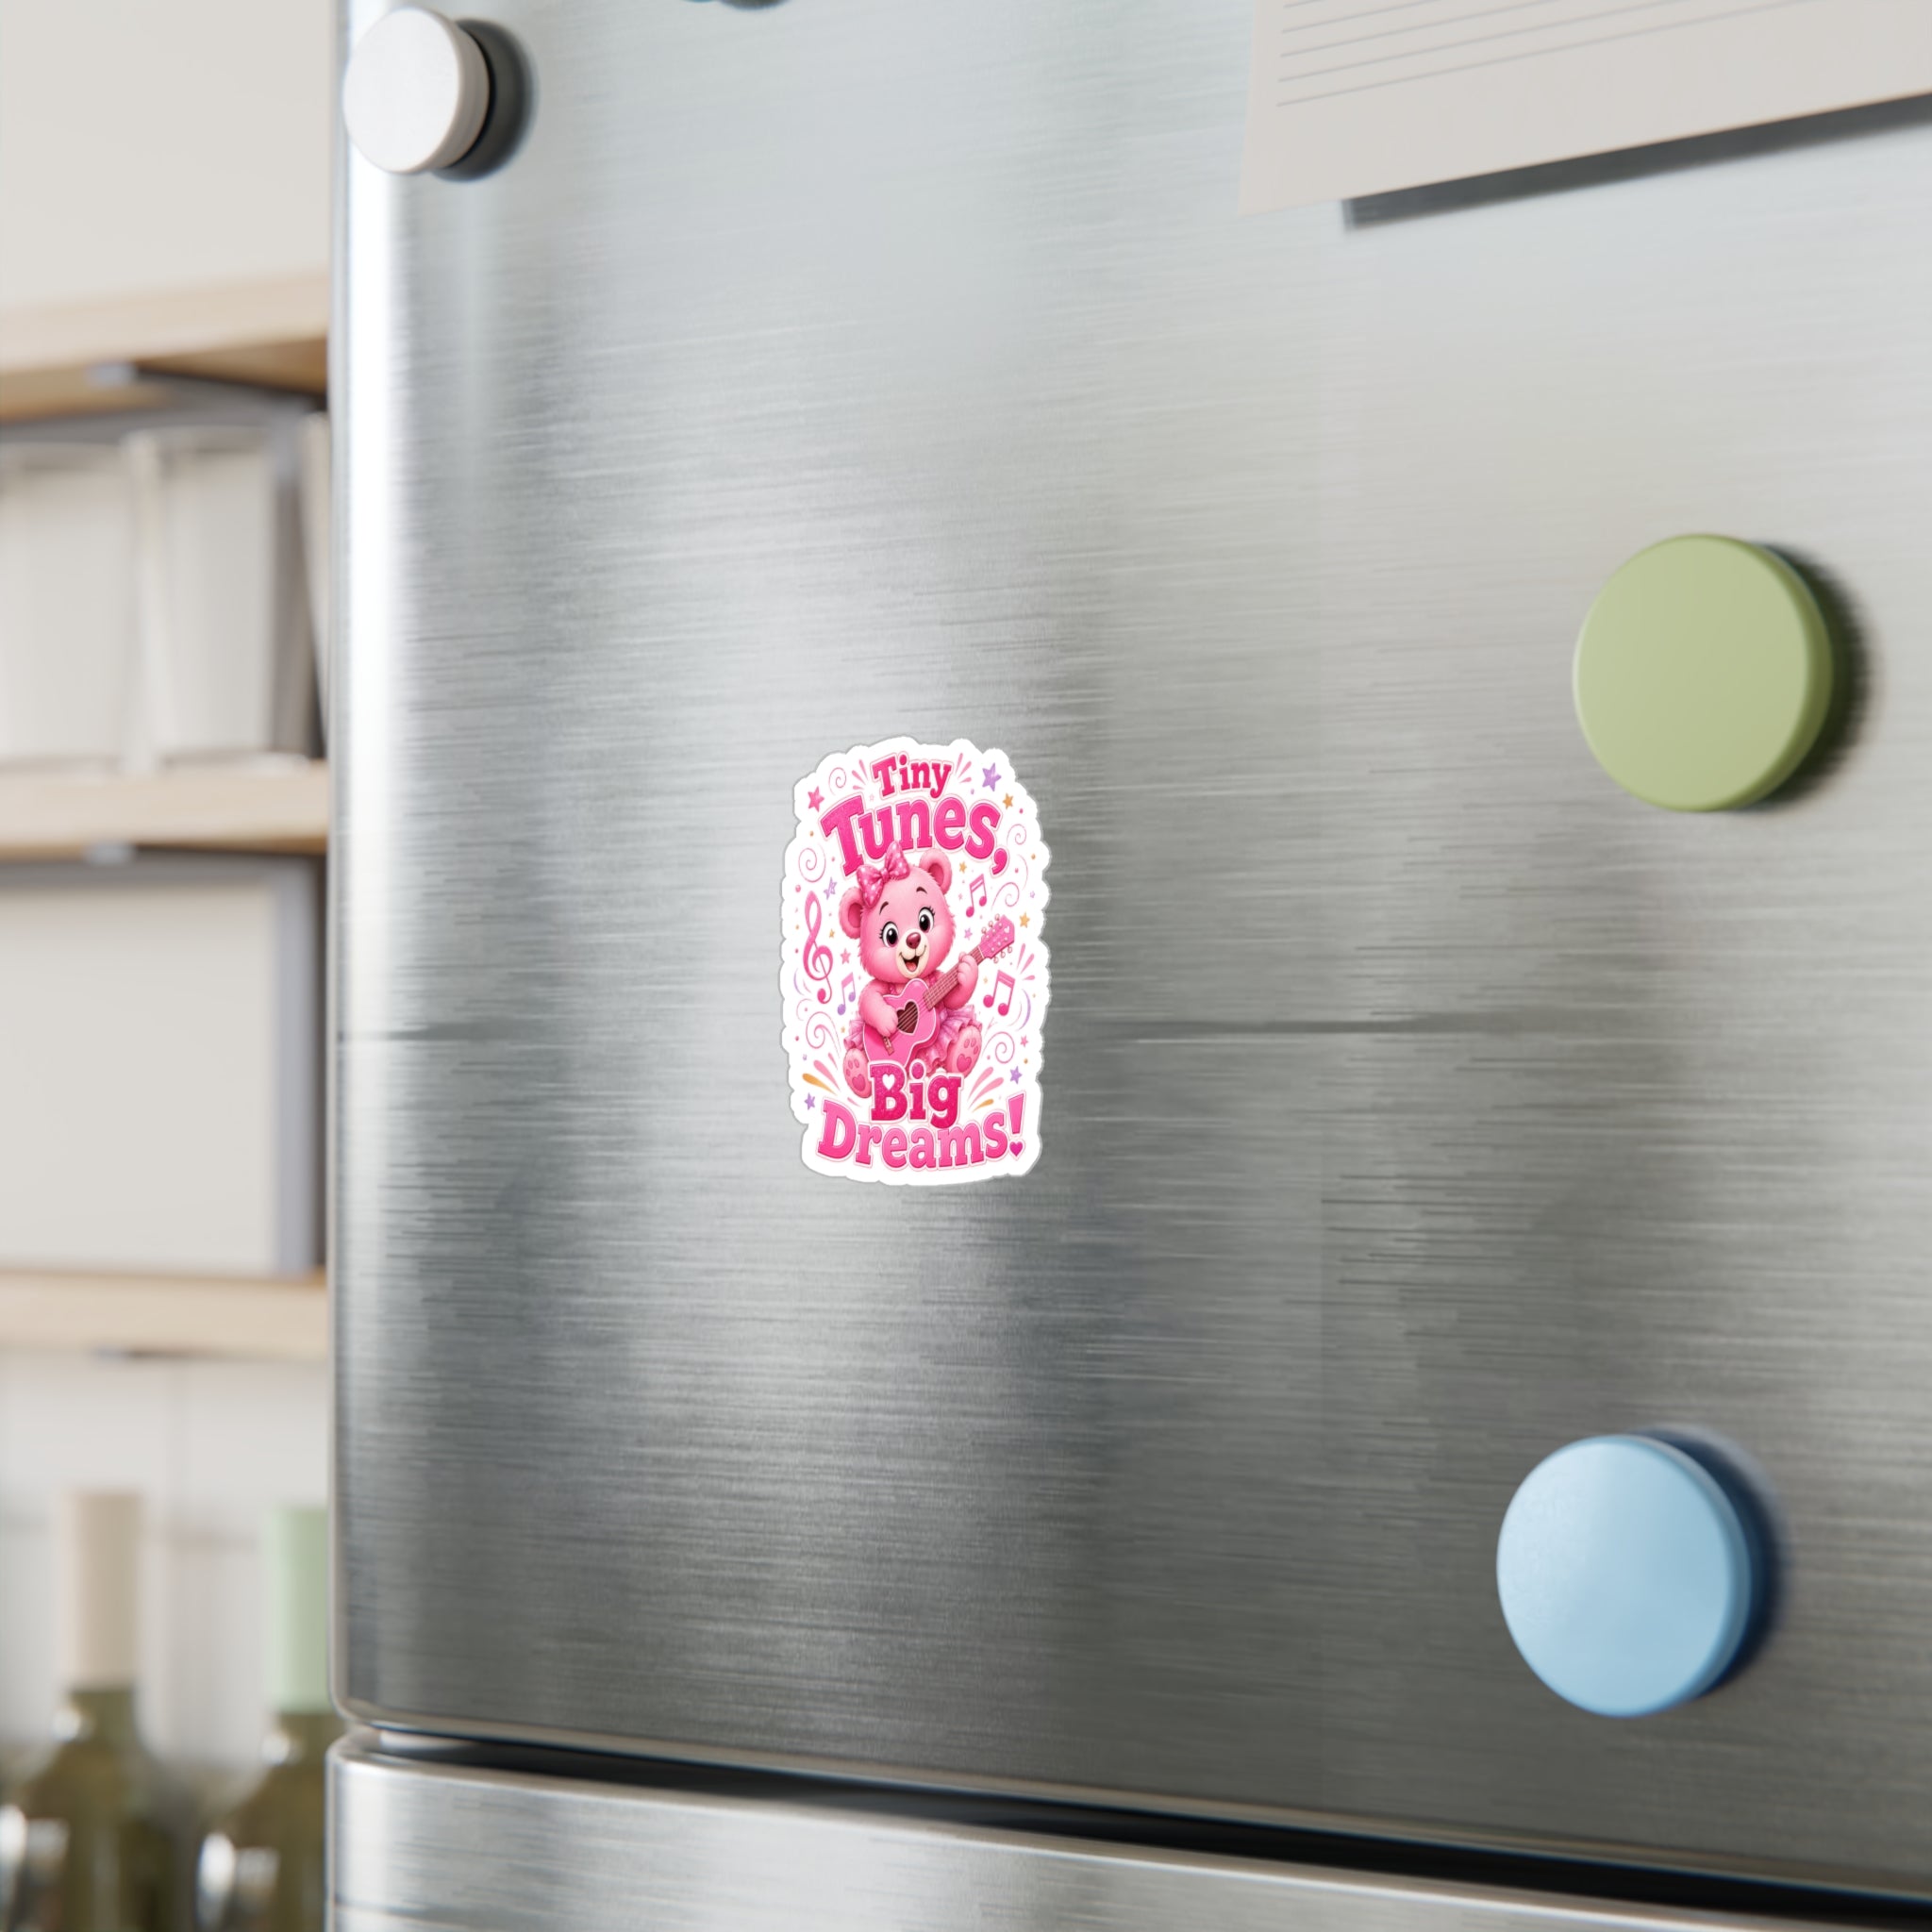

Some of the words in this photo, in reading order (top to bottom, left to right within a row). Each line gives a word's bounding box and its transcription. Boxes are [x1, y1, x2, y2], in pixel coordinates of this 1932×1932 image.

[872, 754, 952, 799] Tiny
[820, 795, 1008, 877] Tunes,
[817, 1093, 1025, 1169] Dreams!
[870, 1061, 962, 1129] Big
